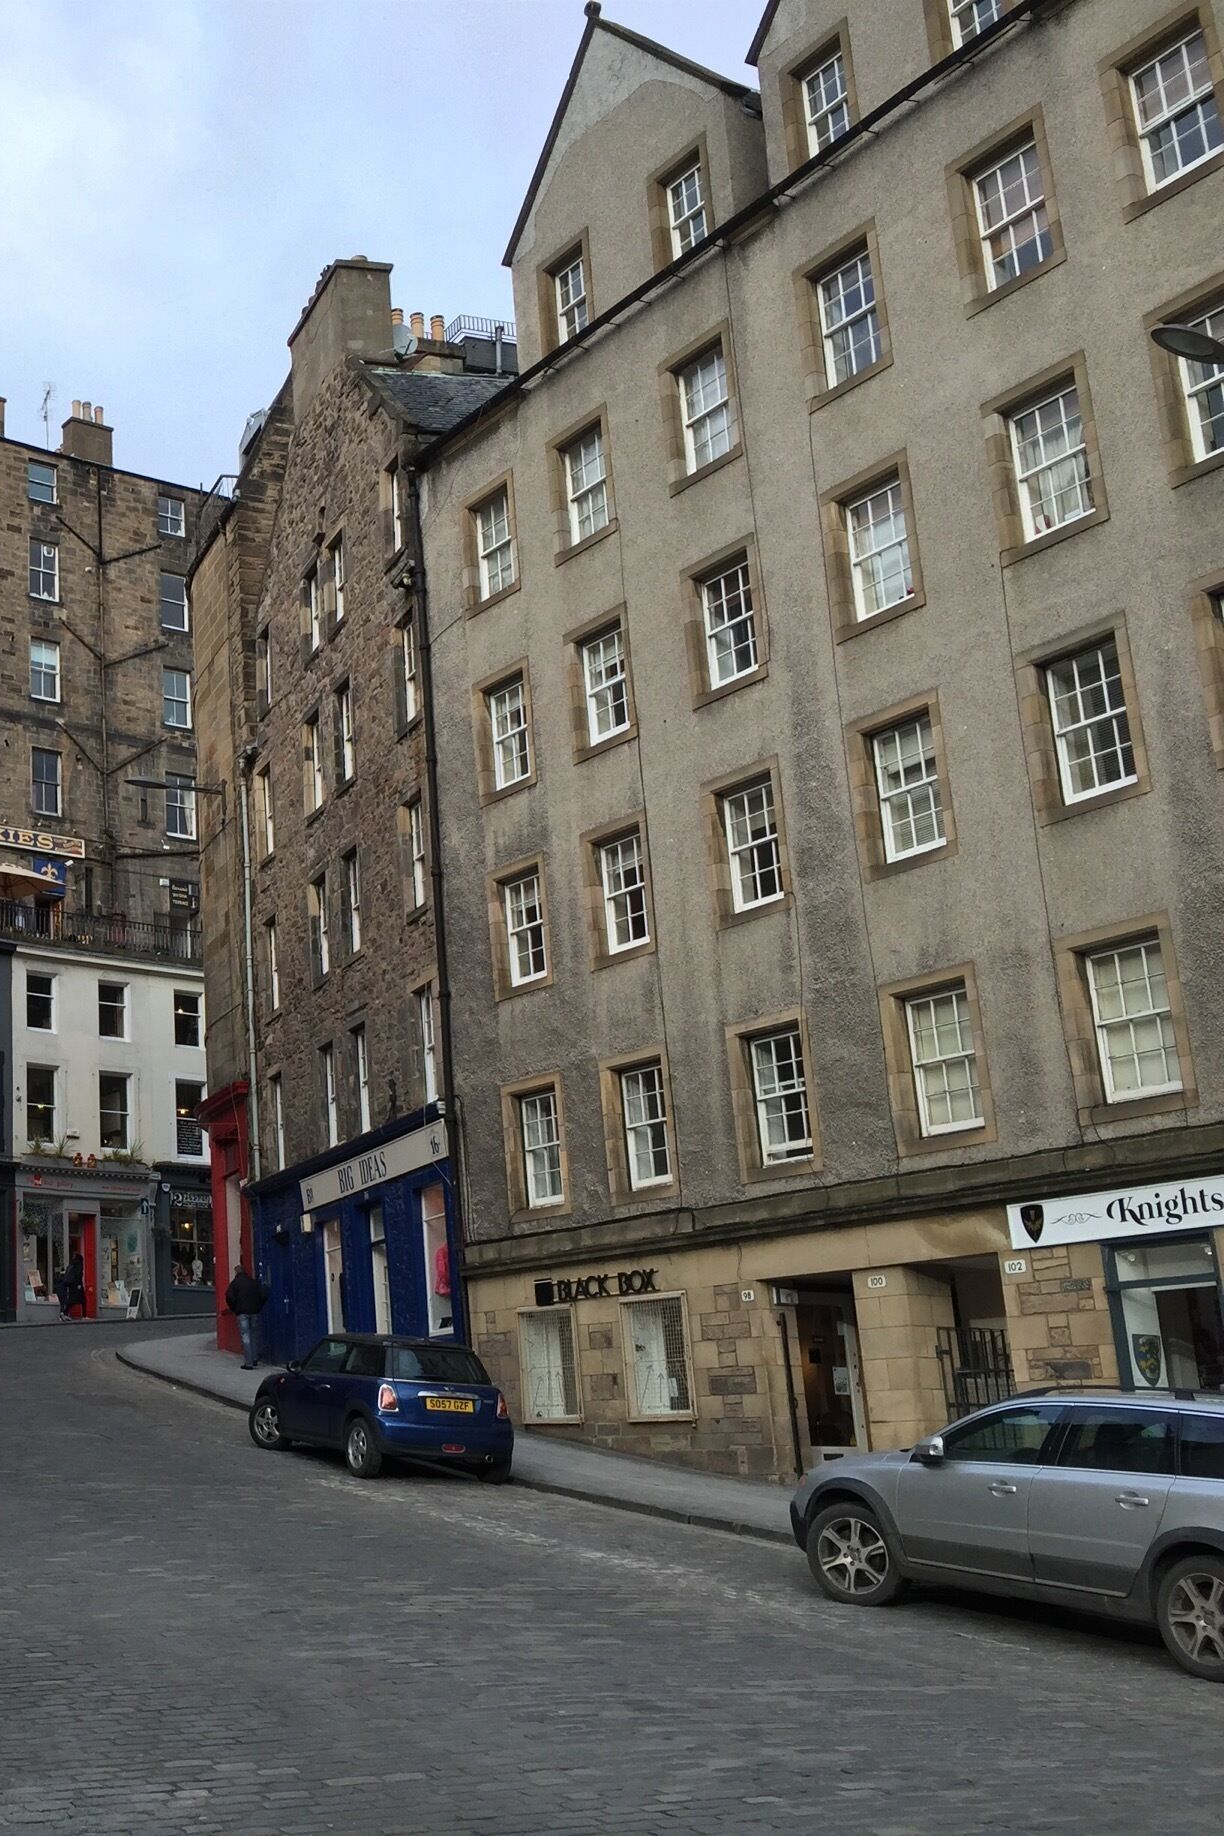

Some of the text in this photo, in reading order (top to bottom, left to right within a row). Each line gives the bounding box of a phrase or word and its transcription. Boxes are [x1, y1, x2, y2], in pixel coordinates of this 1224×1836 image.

[337, 1165, 355, 1194] BIG
[358, 1151, 387, 1186] IDEAS
[1107, 1187, 1224, 1227] Knights
[1007, 1261, 1023, 1272] 102
[556, 1267, 660, 1301] BLACK BOX
[870, 1276, 884, 1287] 100
[743, 1291, 752, 1300] 98
[429, 1399, 470, 1411] SO57 GZF
